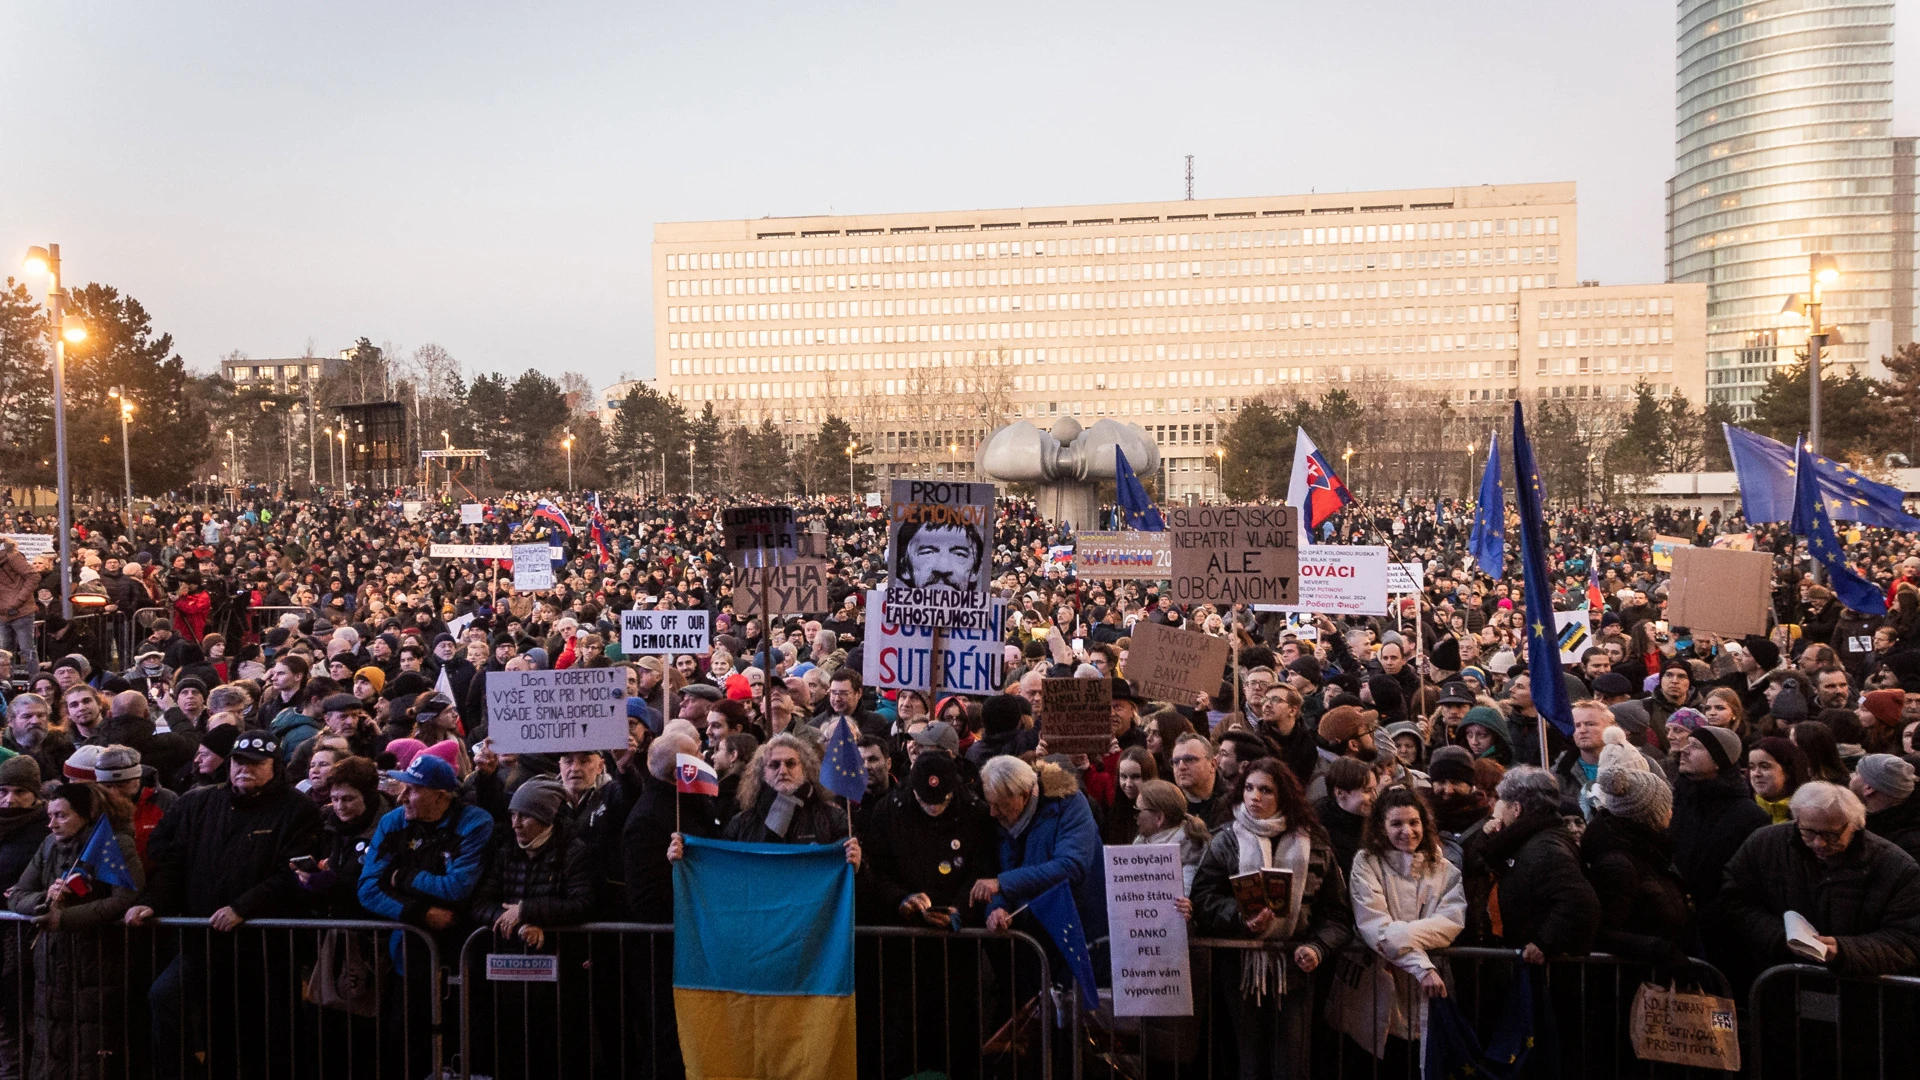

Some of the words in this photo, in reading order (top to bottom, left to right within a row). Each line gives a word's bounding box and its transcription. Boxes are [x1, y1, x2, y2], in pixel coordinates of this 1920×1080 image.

[910, 482, 971, 504] PROTI
[893, 502, 988, 528] DÉMONOVI
[1174, 508, 1288, 527] SLOVENSKO
[1150, 533, 1166, 542] 2022
[1175, 529, 1235, 548] NEPATRÍ
[1247, 528, 1297, 549] VLÁDE,
[1207, 552, 1262, 574] ALE
[1299, 563, 1355, 578] OVÁCI
[747, 583, 819, 612] ХУЙ
[886, 587, 986, 609] BEZOHĽADNEJ
[1306, 600, 1334, 609] Роберт
[625, 615, 653, 630] HANDS
[660, 615, 678, 630] OFF
[687, 615, 705, 630] OUR
[886, 605, 989, 629] ĽAHOSTAJNOSTI
[632, 634, 703, 649] DEMOCRACY
[1157, 628, 1192, 648] TAKTO
[1170, 650, 1201, 668] NAMI
[521, 673, 547, 687] Don
[493, 688, 525, 704] VYŠE
[533, 689, 555, 703] ROK
[559, 690, 575, 702] PRI
[580, 687, 610, 702] MOCI
[493, 705, 532, 722] VŠADE
[1113, 856, 1128, 866] Ste
[1131, 854, 1173, 867] obyčajní
[1113, 871, 1175, 883] zamestnanci
[1115, 892, 1145, 903] nášho
[1135, 909, 1158, 919] FICO
[1130, 929, 1167, 938] DANKO
[1138, 946, 1161, 956] PELE
[1121, 968, 1156, 978] Dávam
[1159, 968, 1181, 978] vám
[1645, 1012, 1673, 1025] FICO
[1712, 1014, 1730, 1022] FCK
